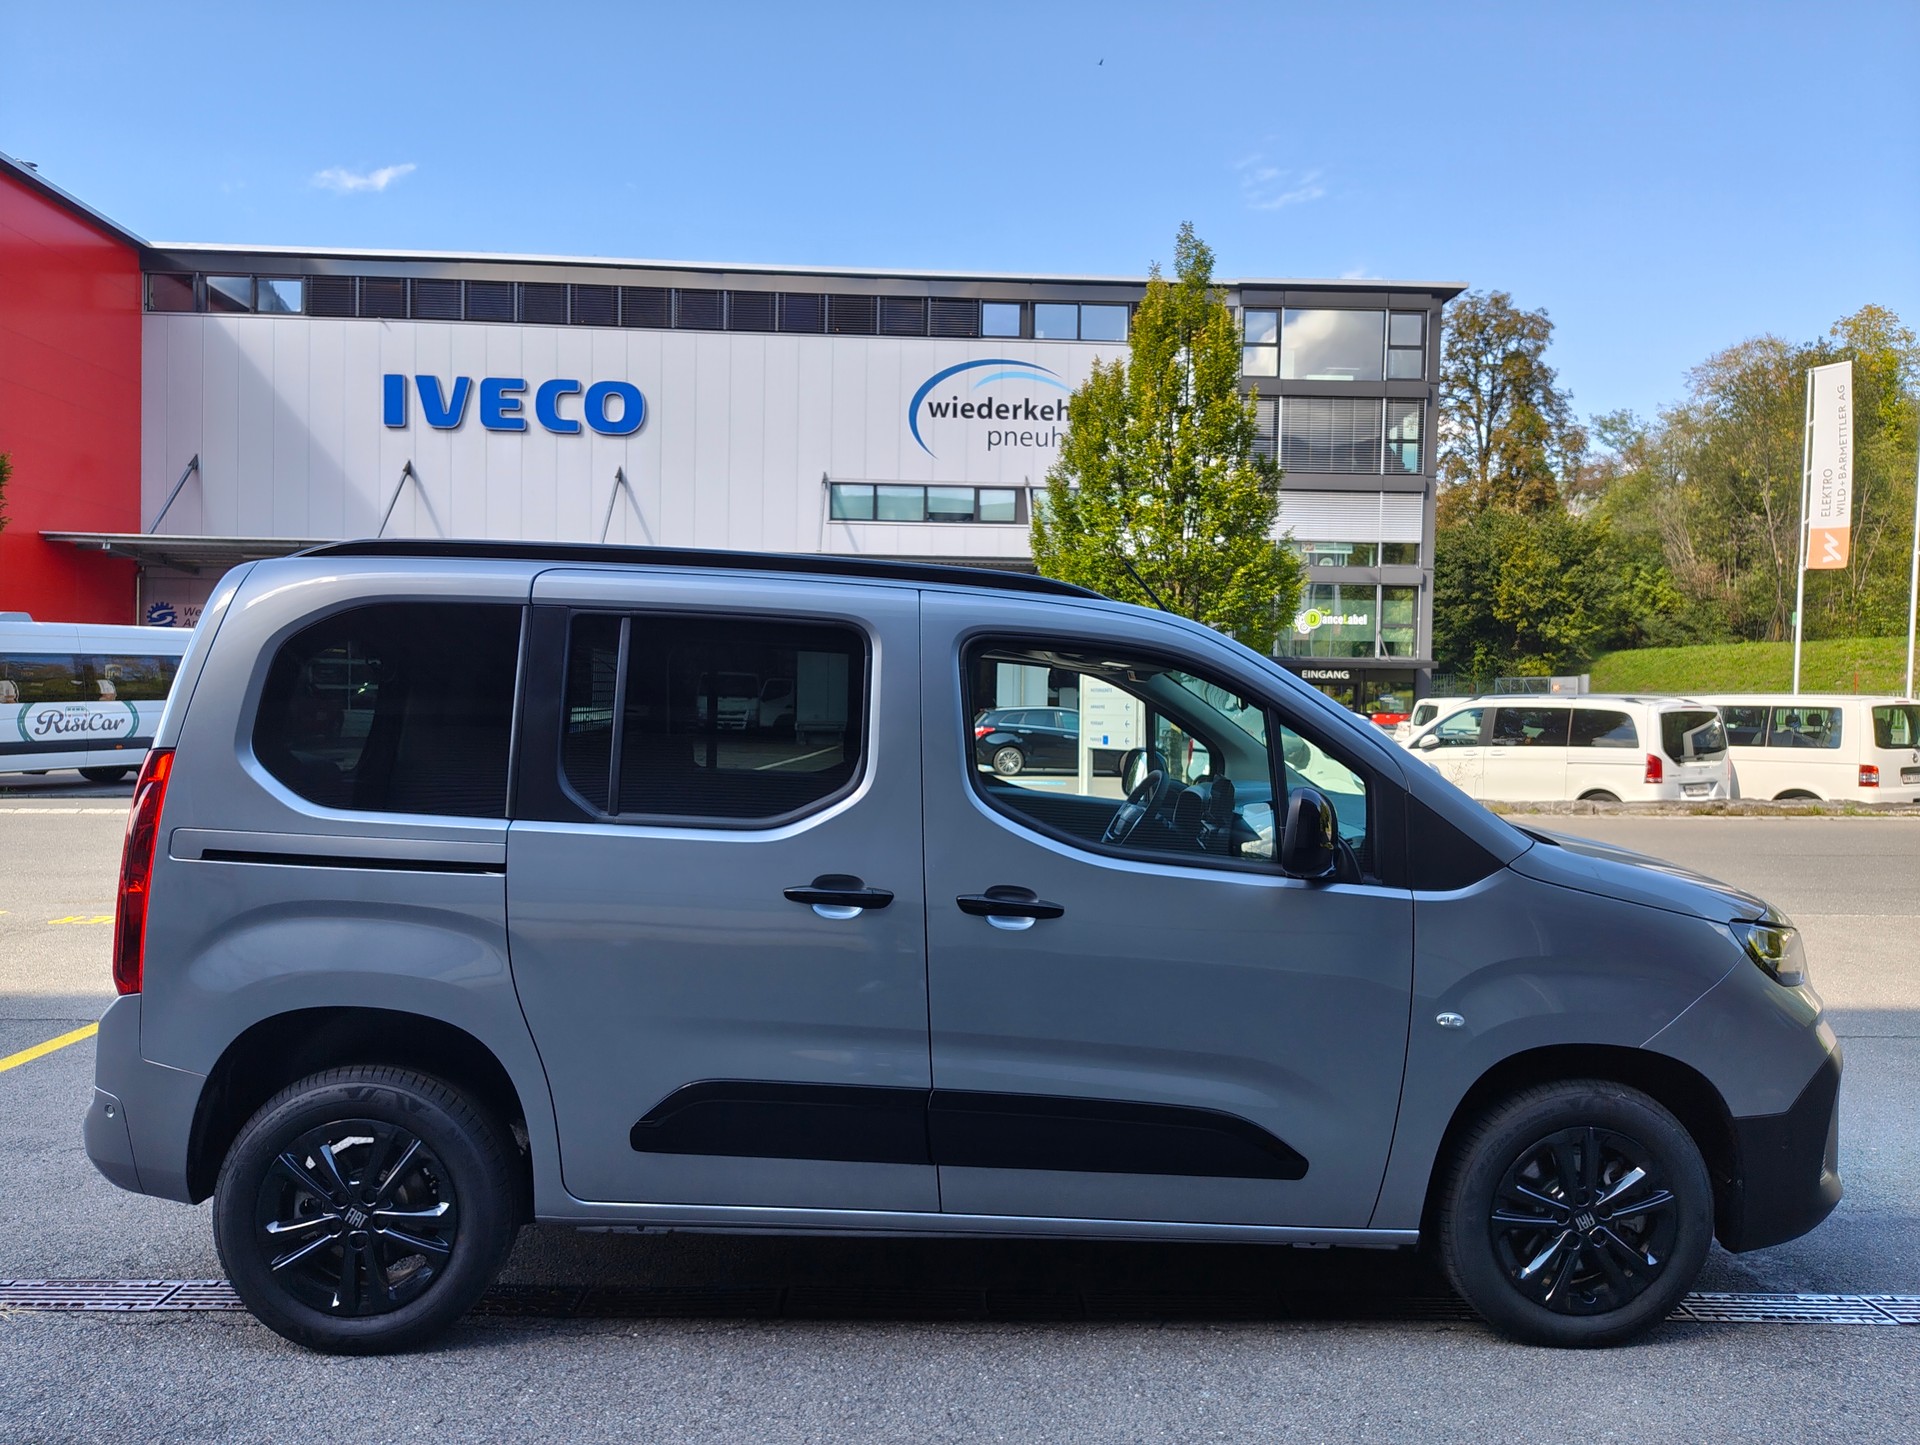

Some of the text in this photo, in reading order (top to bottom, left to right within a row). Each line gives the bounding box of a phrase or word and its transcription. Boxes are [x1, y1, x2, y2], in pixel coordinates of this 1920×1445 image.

[384, 374, 645, 435] IVECO
[1836, 384, 1846, 405] AG
[928, 396, 1071, 421] wiederkeh
[987, 426, 1063, 451] pneuh
[1820, 468, 1834, 518] ELEKTRO
[1301, 669, 1350, 680] EINGANG
[34, 709, 125, 735] RisiCar
[345, 1207, 368, 1228] FIAT
[1575, 1212, 1596, 1232] FIAT
